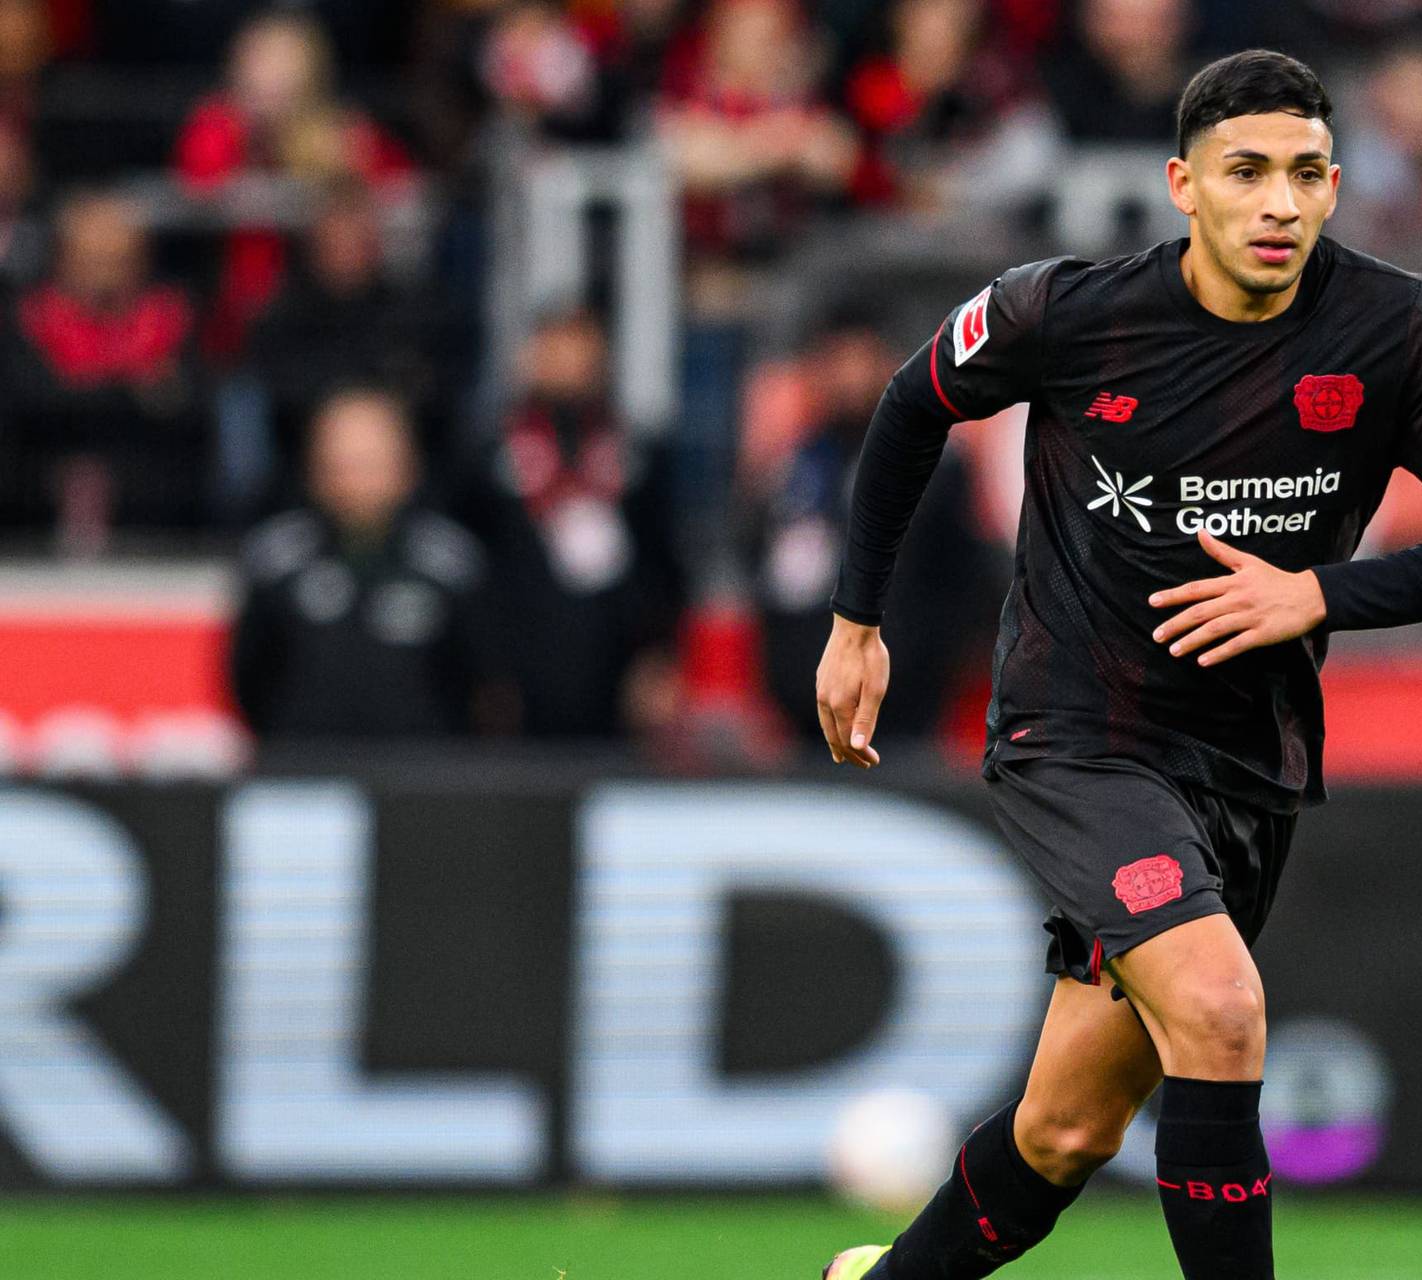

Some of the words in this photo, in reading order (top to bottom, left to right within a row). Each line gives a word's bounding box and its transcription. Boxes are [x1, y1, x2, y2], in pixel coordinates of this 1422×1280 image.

[1084, 391, 1138, 423] NB
[1180, 467, 1341, 502] Barmenia
[1176, 505, 1317, 537] Gothaer
